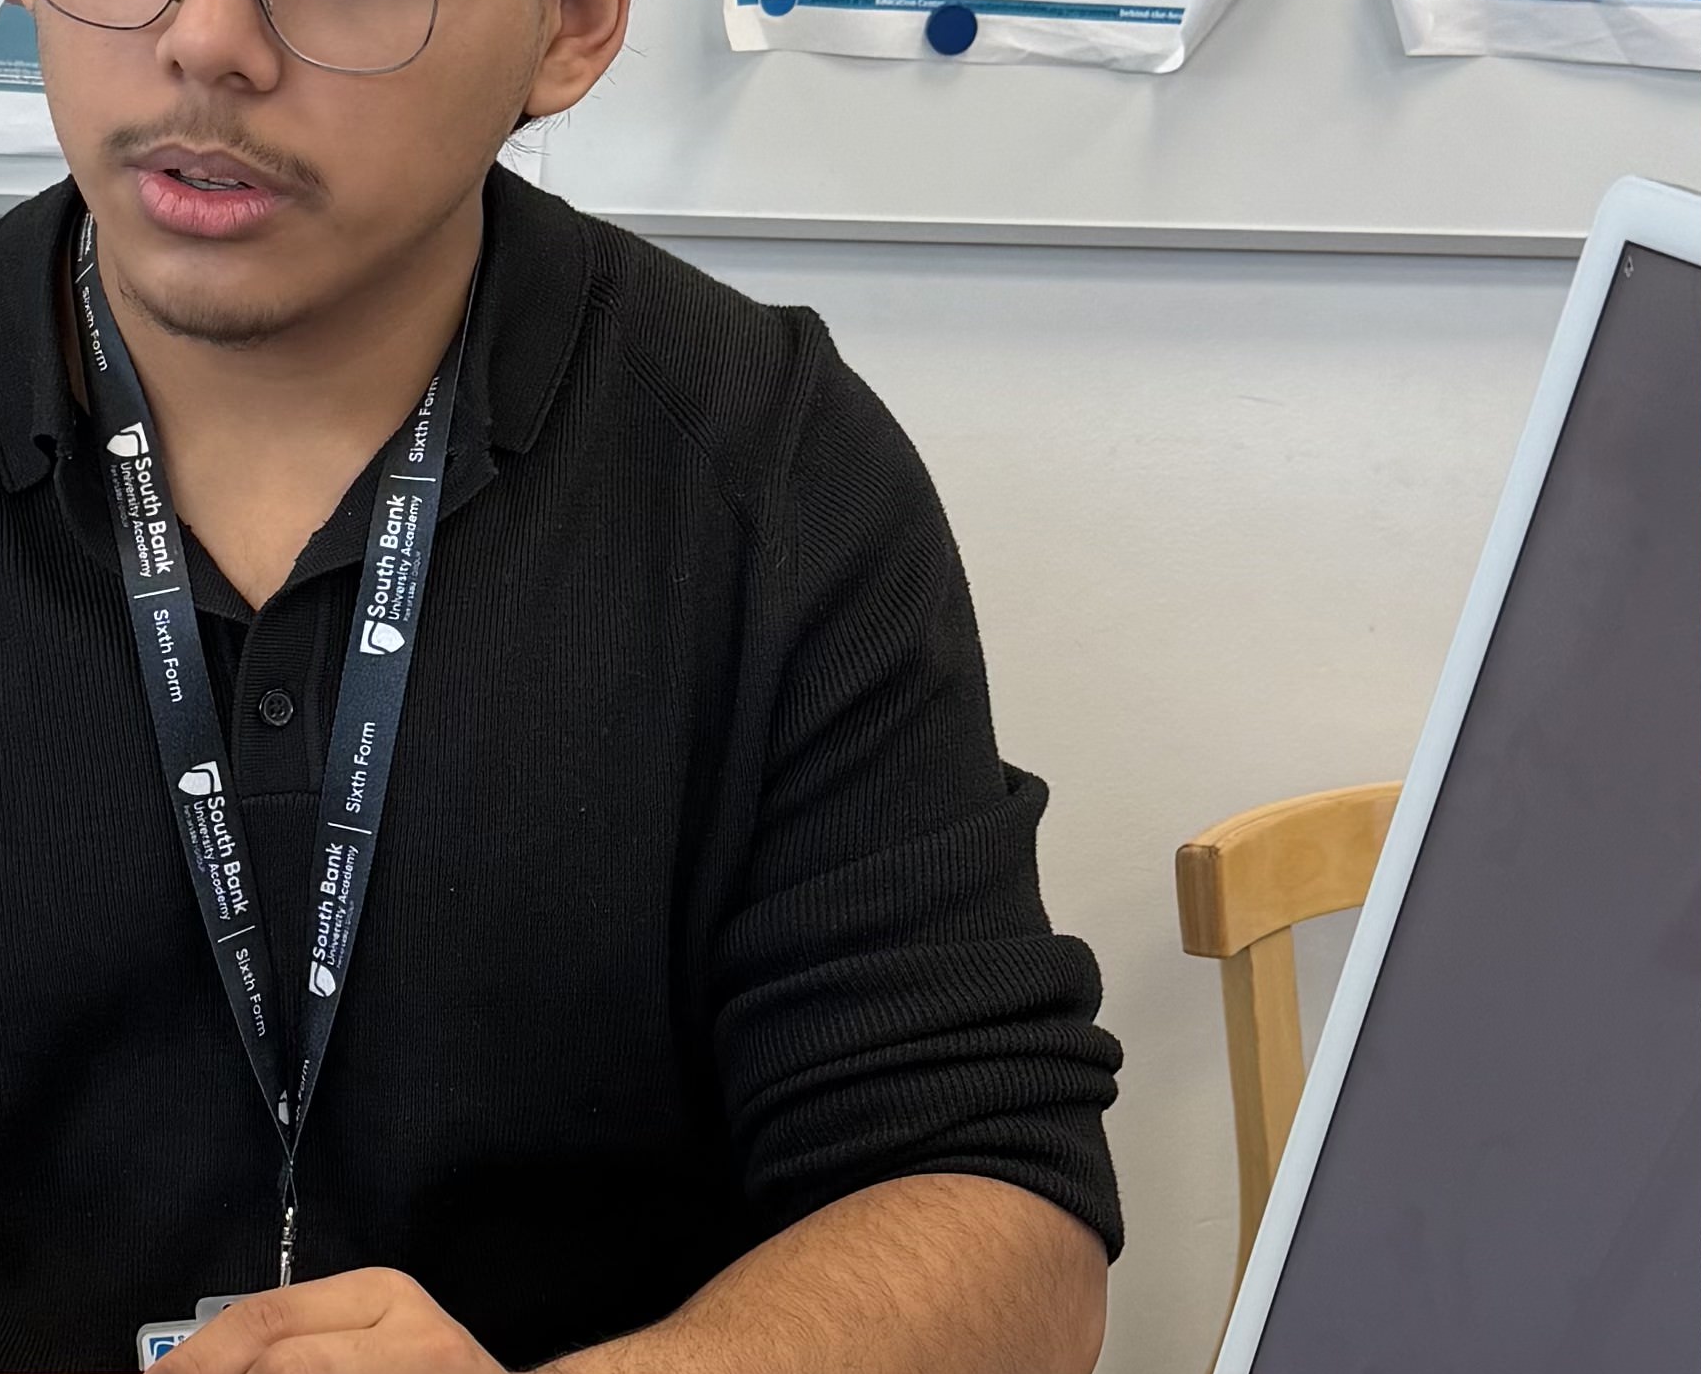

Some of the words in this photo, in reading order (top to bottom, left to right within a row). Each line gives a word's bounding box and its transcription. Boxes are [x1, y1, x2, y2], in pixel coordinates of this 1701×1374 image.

[408, 421, 429, 463] Sixth
[120, 462, 139, 518] University
[131, 520, 152, 578] Academy
[134, 457, 157, 517] South
[148, 520, 175, 574] Bank
[380, 494, 406, 550] Bank
[388, 560, 412, 621] University
[403, 495, 423, 558] Academy
[367, 554, 396, 619] South
[153, 609, 173, 653] Sixth
[163, 657, 183, 703] Form
[354, 721, 376, 767] Form
[346, 769, 367, 814] Sixth
[193, 800, 215, 861] University
[208, 862, 232, 921] Academy
[207, 796, 236, 858] South
[224, 860, 250, 915] Bank
[321, 842, 344, 895] Bank
[312, 901, 334, 960] South
[327, 906, 347, 966] University
[339, 845, 359, 905] Academy
[235, 947, 256, 992] Sixth
[250, 993, 266, 1037] Form
